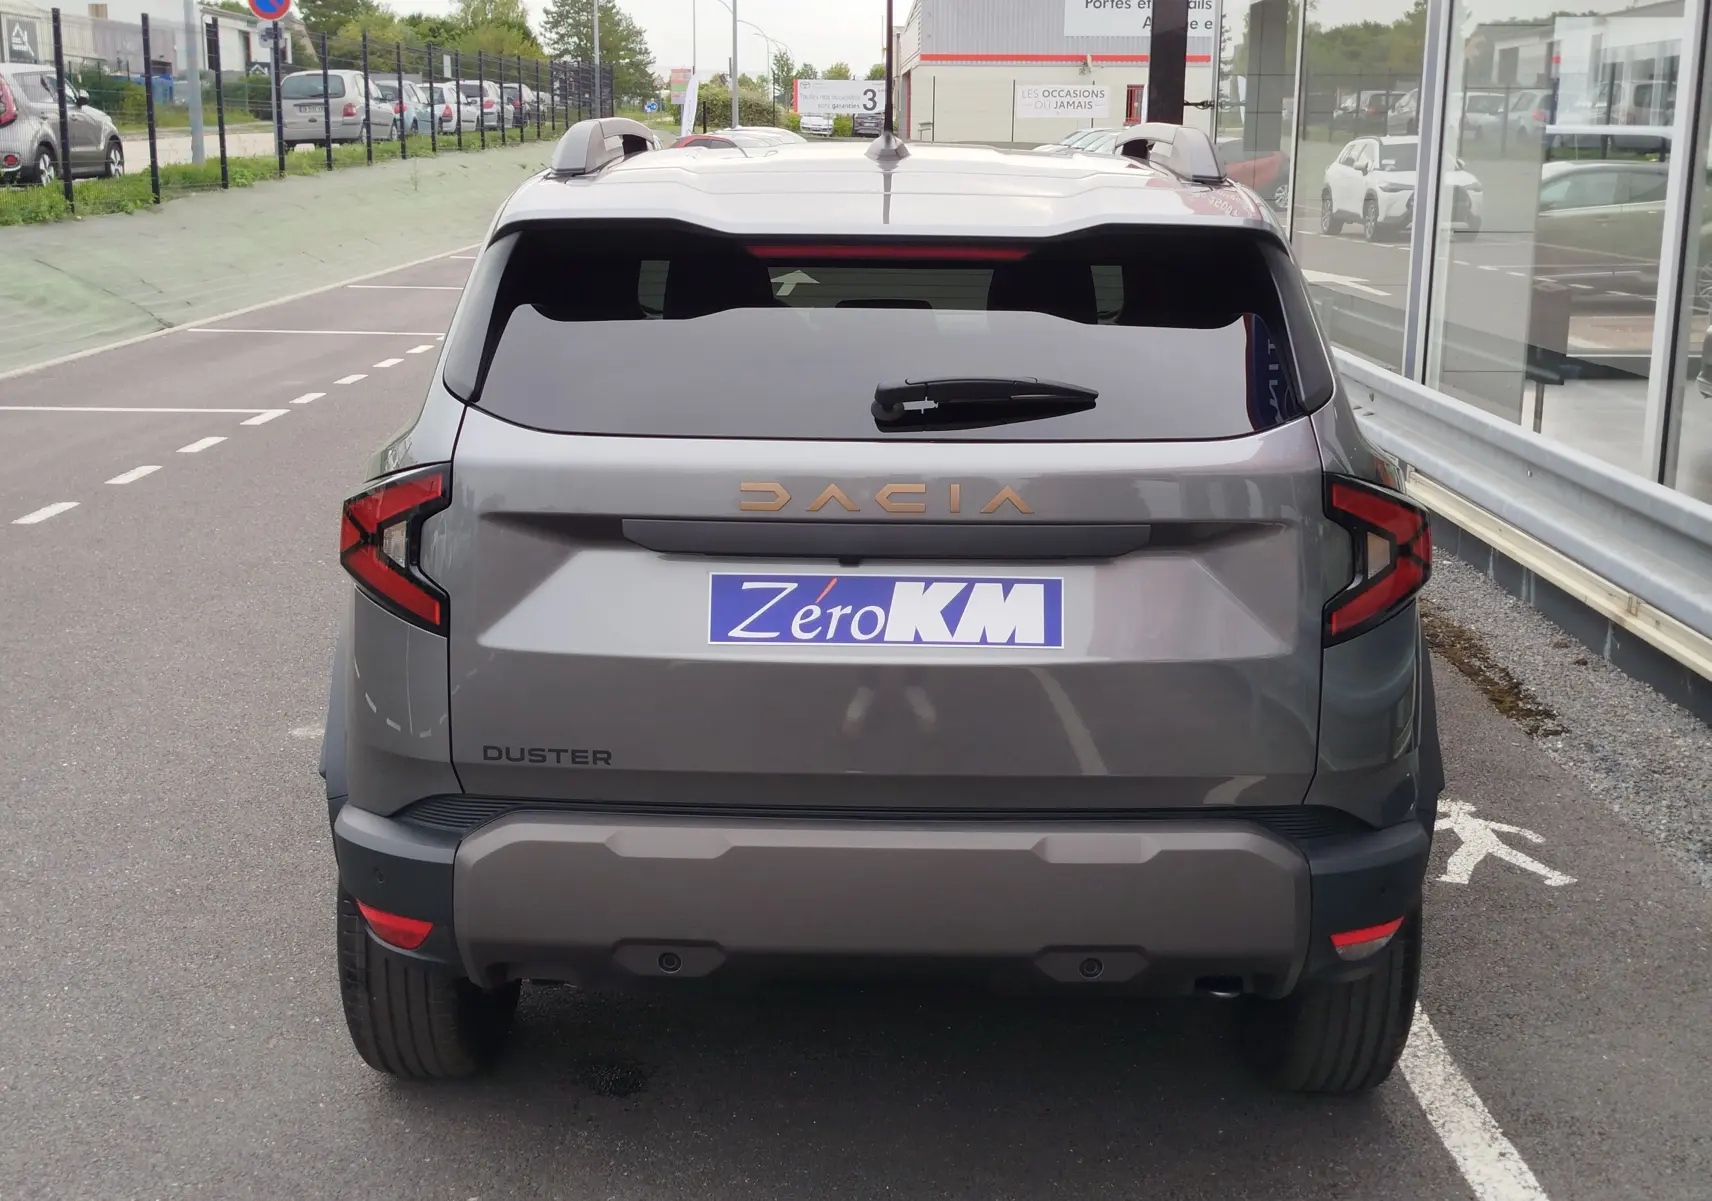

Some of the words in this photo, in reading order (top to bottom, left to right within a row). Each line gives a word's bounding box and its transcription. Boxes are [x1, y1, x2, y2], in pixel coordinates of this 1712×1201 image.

[1085, 0, 1131, 9] Portes
[832, 102, 860, 110] garanties
[862, 88, 878, 111] 3
[1022, 89, 1039, 98] LES
[1042, 89, 1105, 98] OCCASIONS
[1034, 101, 1051, 109] OU
[1054, 101, 1093, 110] JAMAIS
[740, 481, 1035, 515] DACIA
[483, 745, 612, 766] DUSTER
